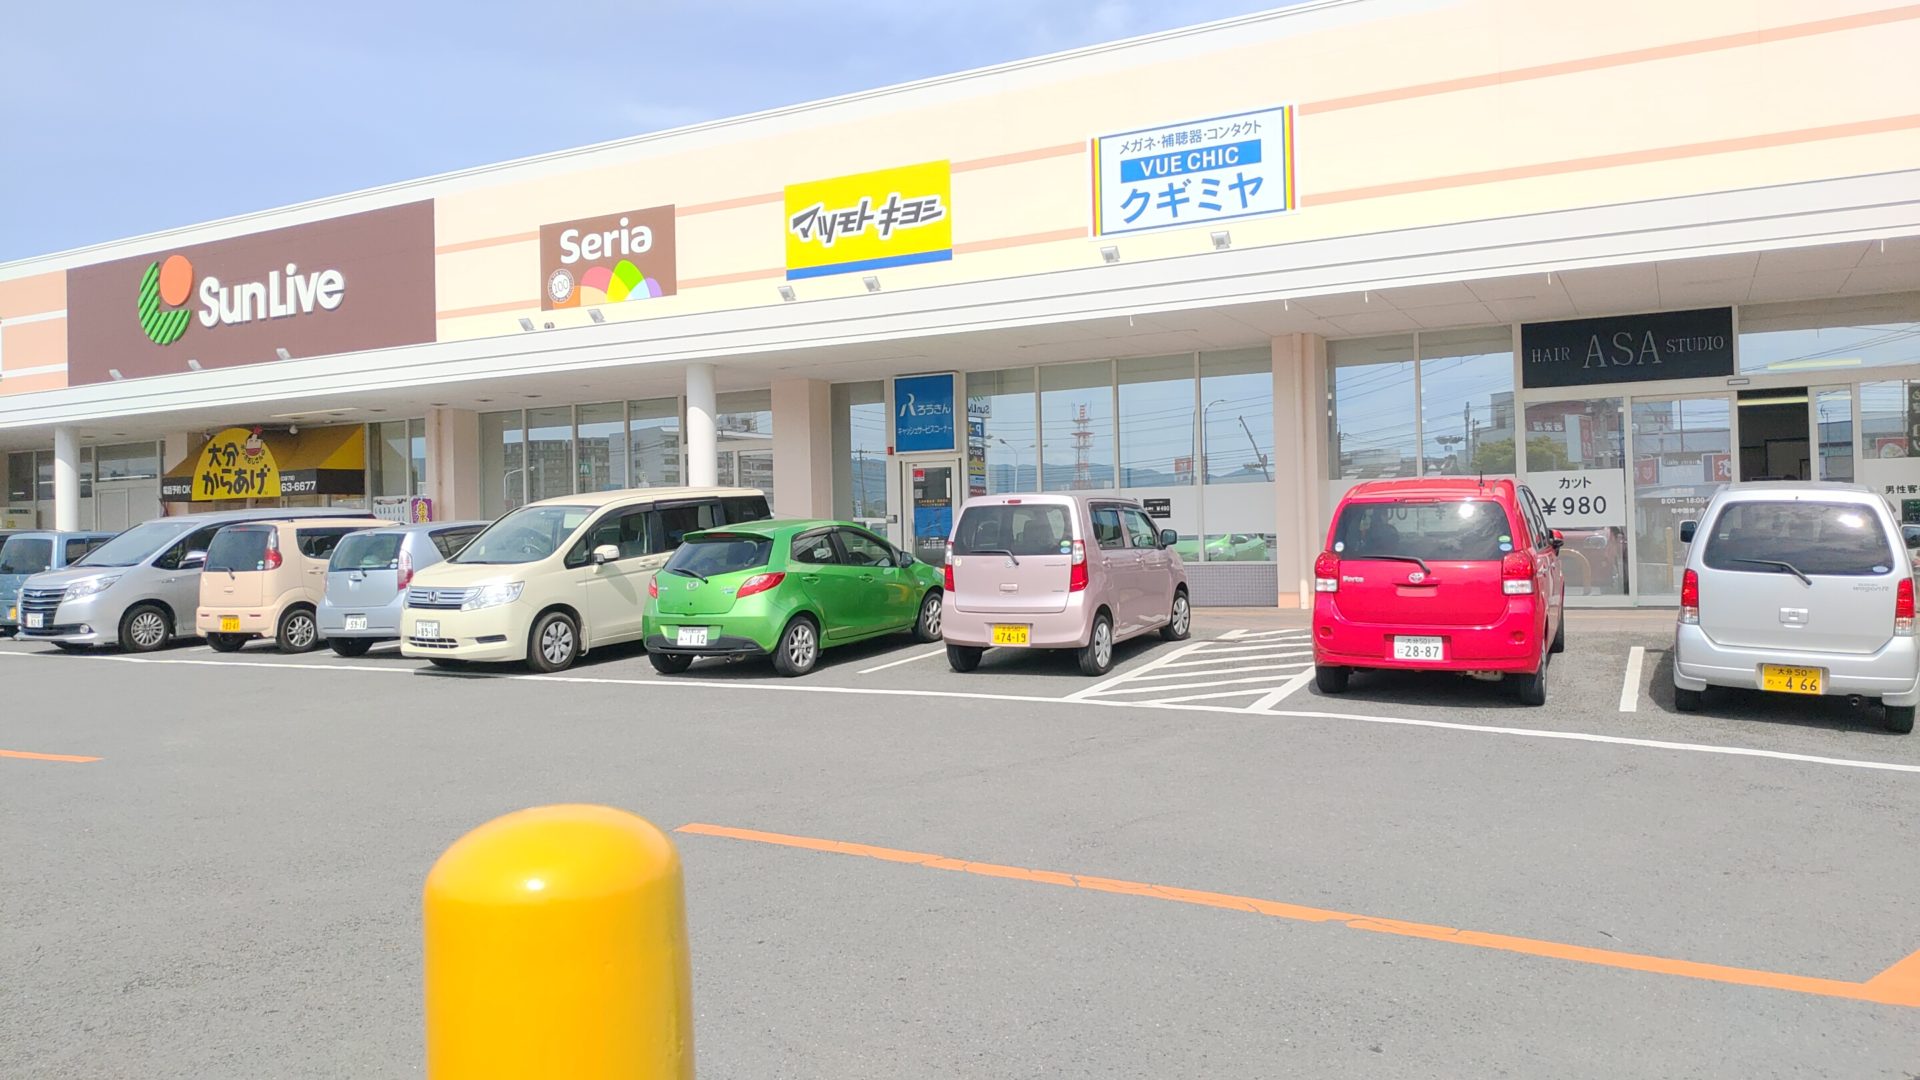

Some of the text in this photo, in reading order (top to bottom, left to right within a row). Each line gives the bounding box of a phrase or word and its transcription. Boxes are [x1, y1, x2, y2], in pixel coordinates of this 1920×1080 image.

[1120, 120, 1262, 154] メガネ・補聴器・コンタクト
[1140, 146, 1240, 177] VUE CHIC
[1120, 172, 1264, 224] クギミヤ
[791, 196, 943, 243] マツモトキヨシ
[559, 217, 653, 264] Seria
[198, 262, 345, 328] SunLive
[1531, 330, 1725, 369] HAIR ASA STUDIO
[208, 442, 240, 467] 大分
[202, 464, 271, 496] からあげ
[280, 481, 317, 492] 63-6677
[1558, 476, 1592, 490] カット
[1885, 484, 1920, 495] 男性客
[1541, 495, 1607, 516] ¥980
[1001, 632, 1026, 643] 74-19
[1405, 645, 1440, 658] 28-87
